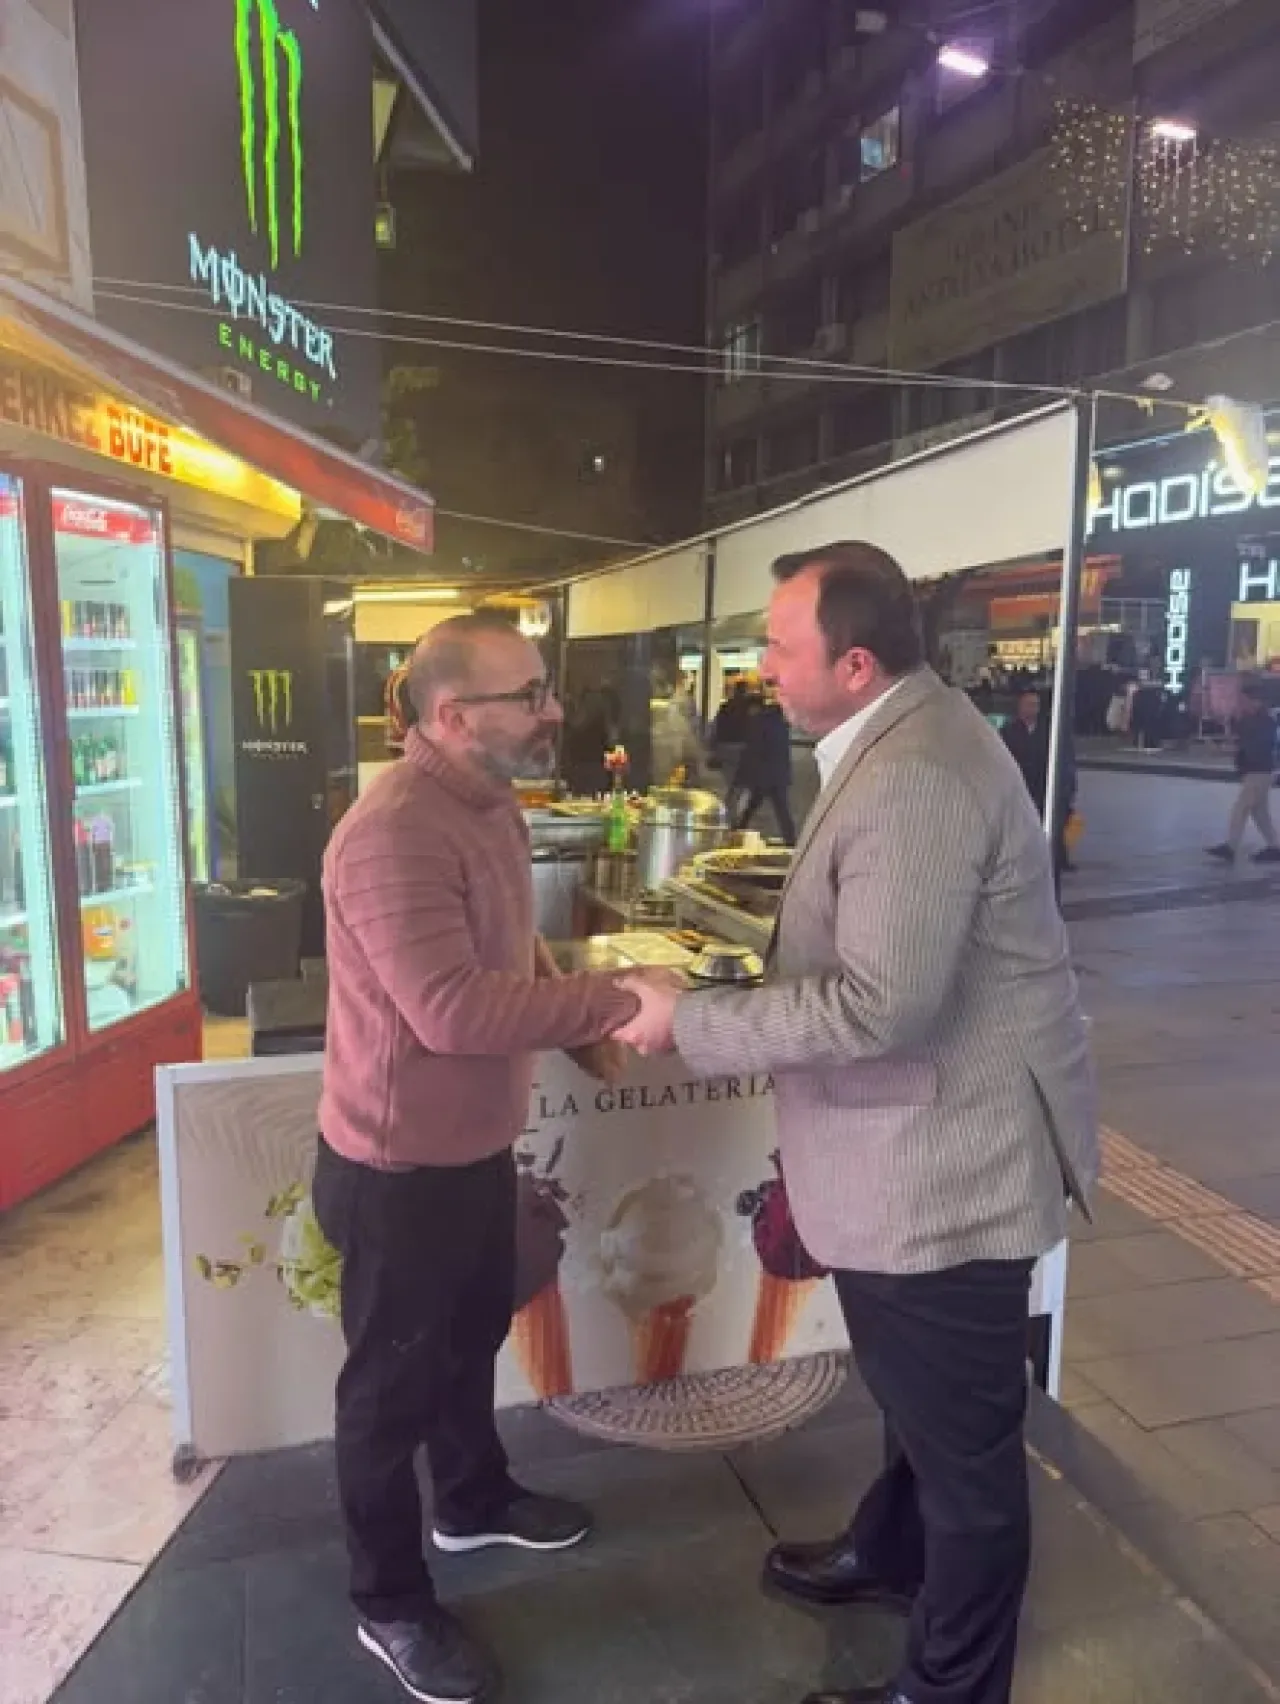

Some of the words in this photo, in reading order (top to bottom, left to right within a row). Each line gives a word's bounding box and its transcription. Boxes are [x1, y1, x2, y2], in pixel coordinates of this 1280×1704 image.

[218, 322, 322, 402] ENERGY
[539, 1093, 579, 1119] LA
[595, 1072, 776, 1113] GELATERIA
